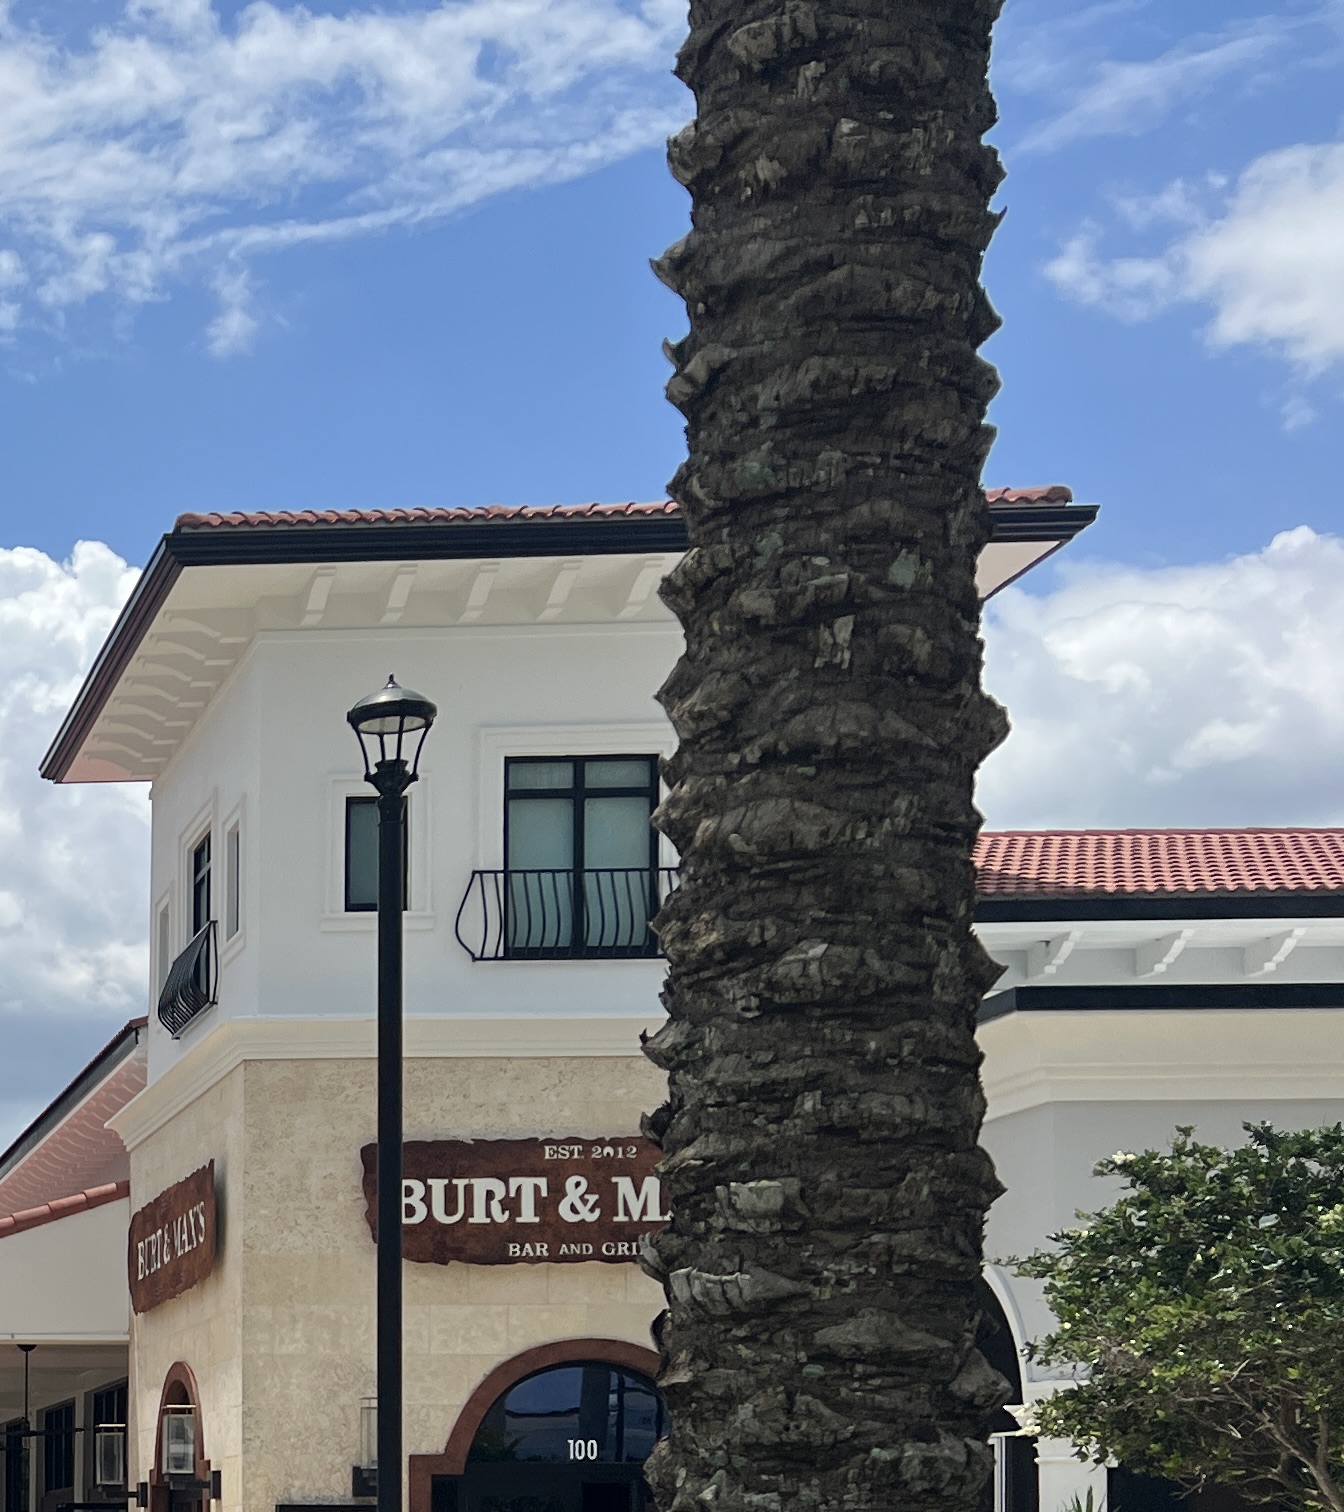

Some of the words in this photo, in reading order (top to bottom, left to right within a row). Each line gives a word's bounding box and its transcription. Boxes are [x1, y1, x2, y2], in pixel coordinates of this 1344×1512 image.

[591, 1145, 638, 1160] 2012
[402, 1177, 548, 1225] BURT
[558, 1175, 601, 1223] &
[137, 1228, 162, 1281] BURT
[173, 1200, 205, 1259] MAX'S
[507, 1241, 550, 1258] BAR
[558, 1242, 594, 1256] AND
[566, 1438, 599, 1461] 100
